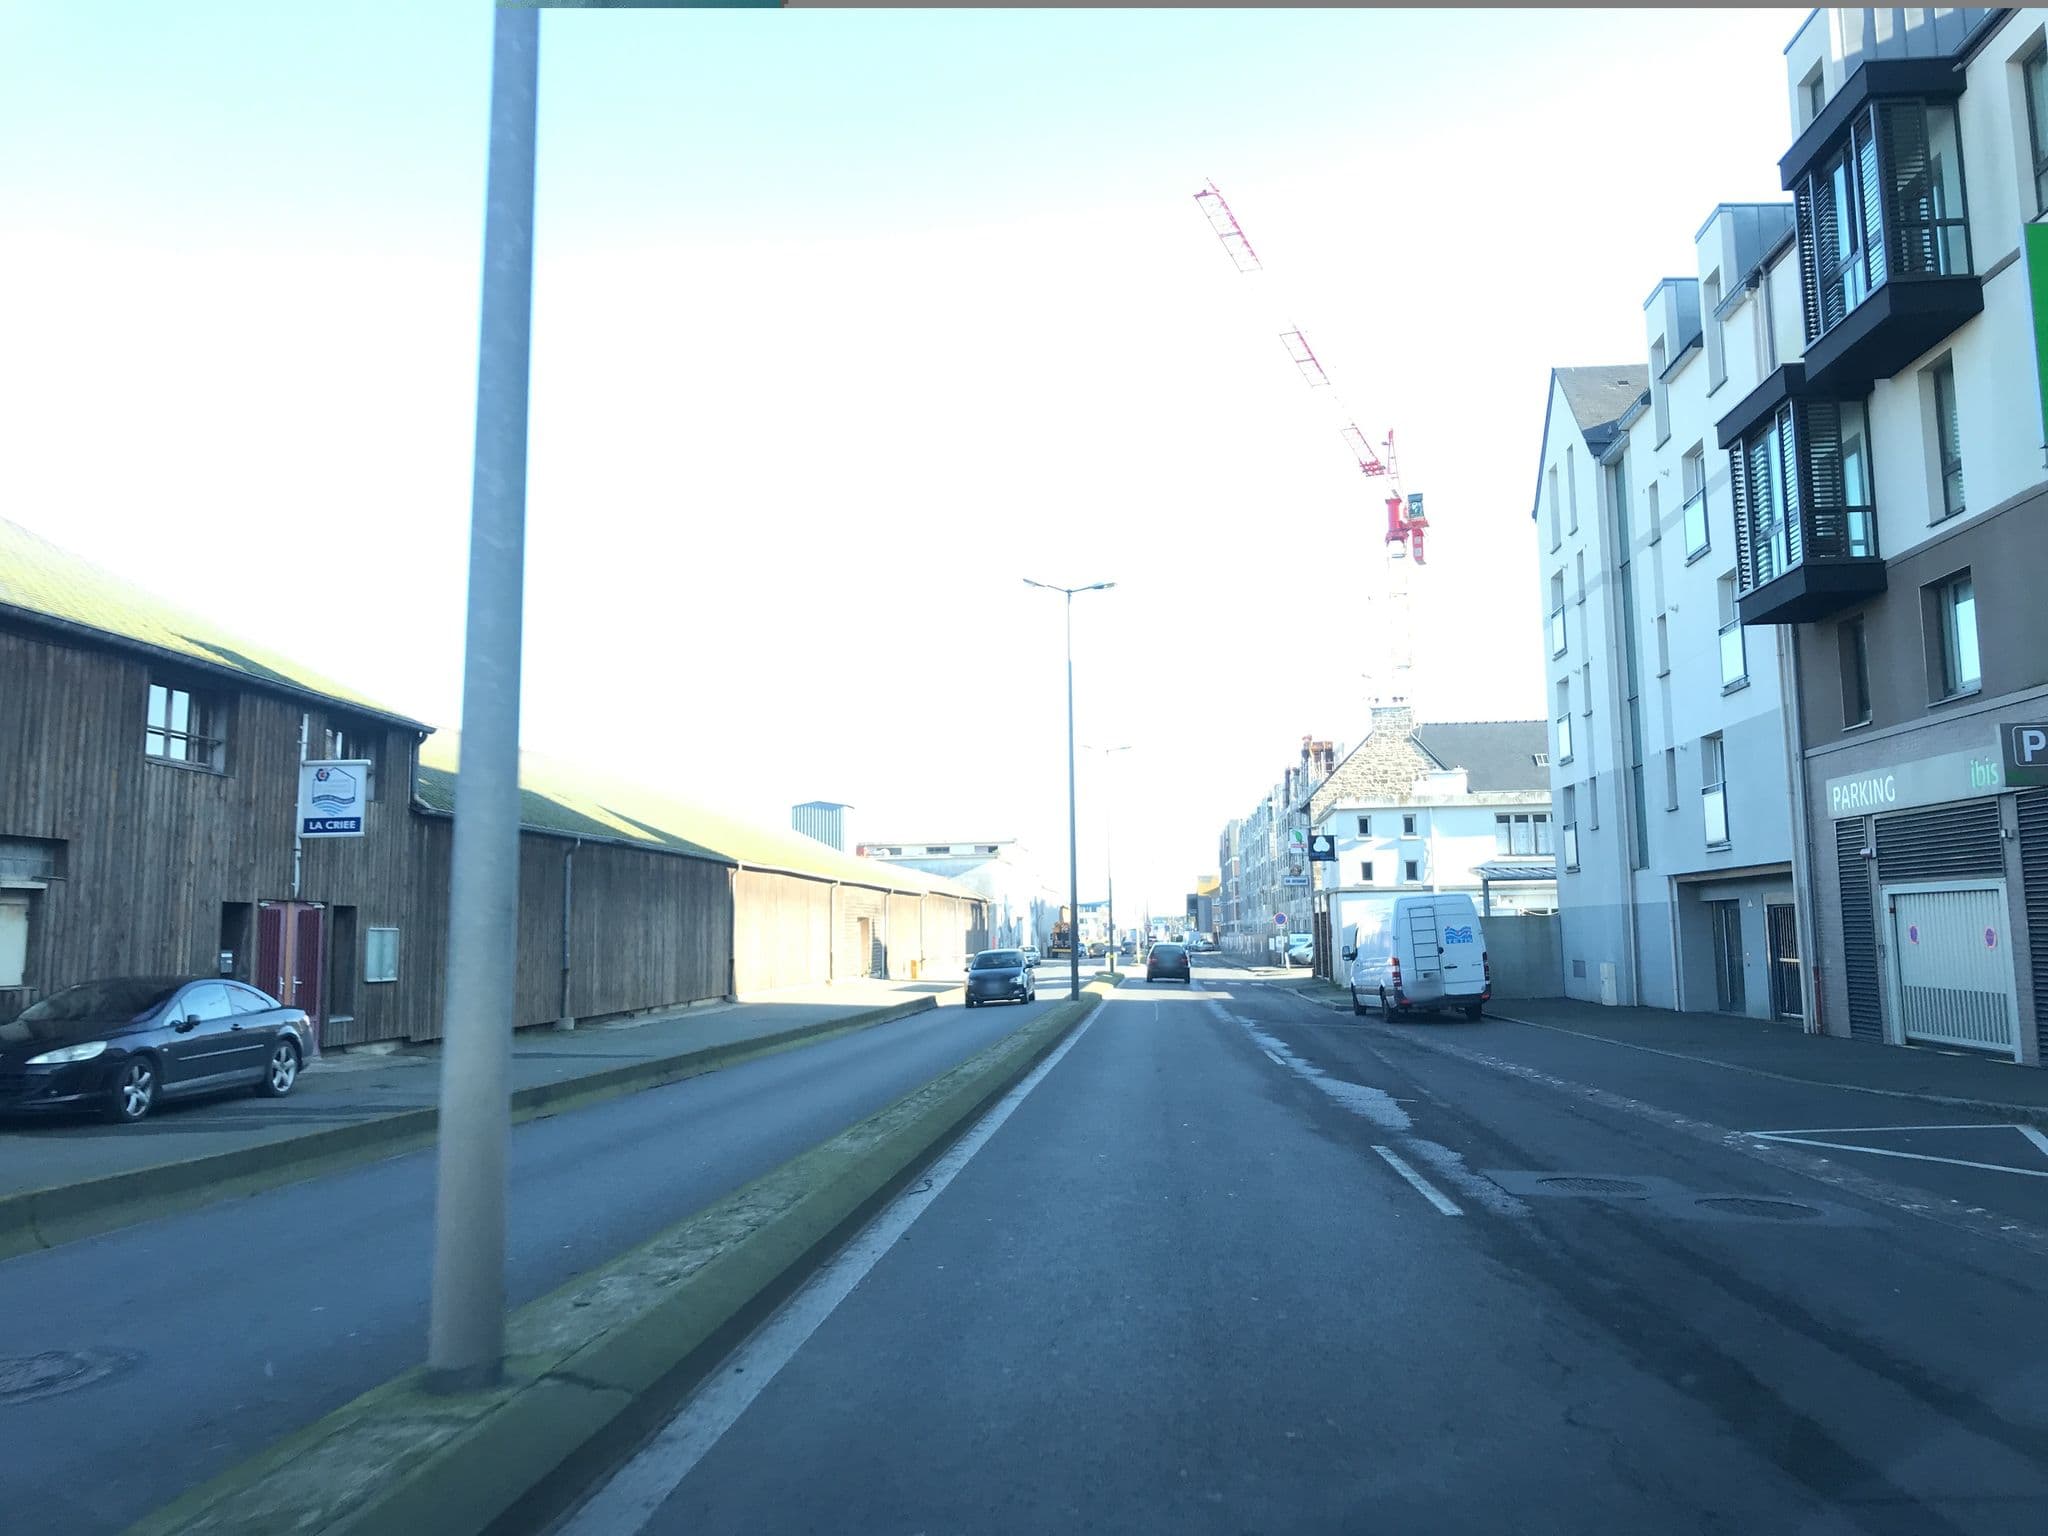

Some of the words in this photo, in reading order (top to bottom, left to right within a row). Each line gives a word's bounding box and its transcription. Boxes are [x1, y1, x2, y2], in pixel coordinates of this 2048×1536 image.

[2022, 729, 2047, 762] P
[1832, 775, 1896, 812] PARKING
[1969, 757, 1999, 789] ibis
[309, 821, 323, 830] LA
[325, 820, 356, 830] CRIEE
